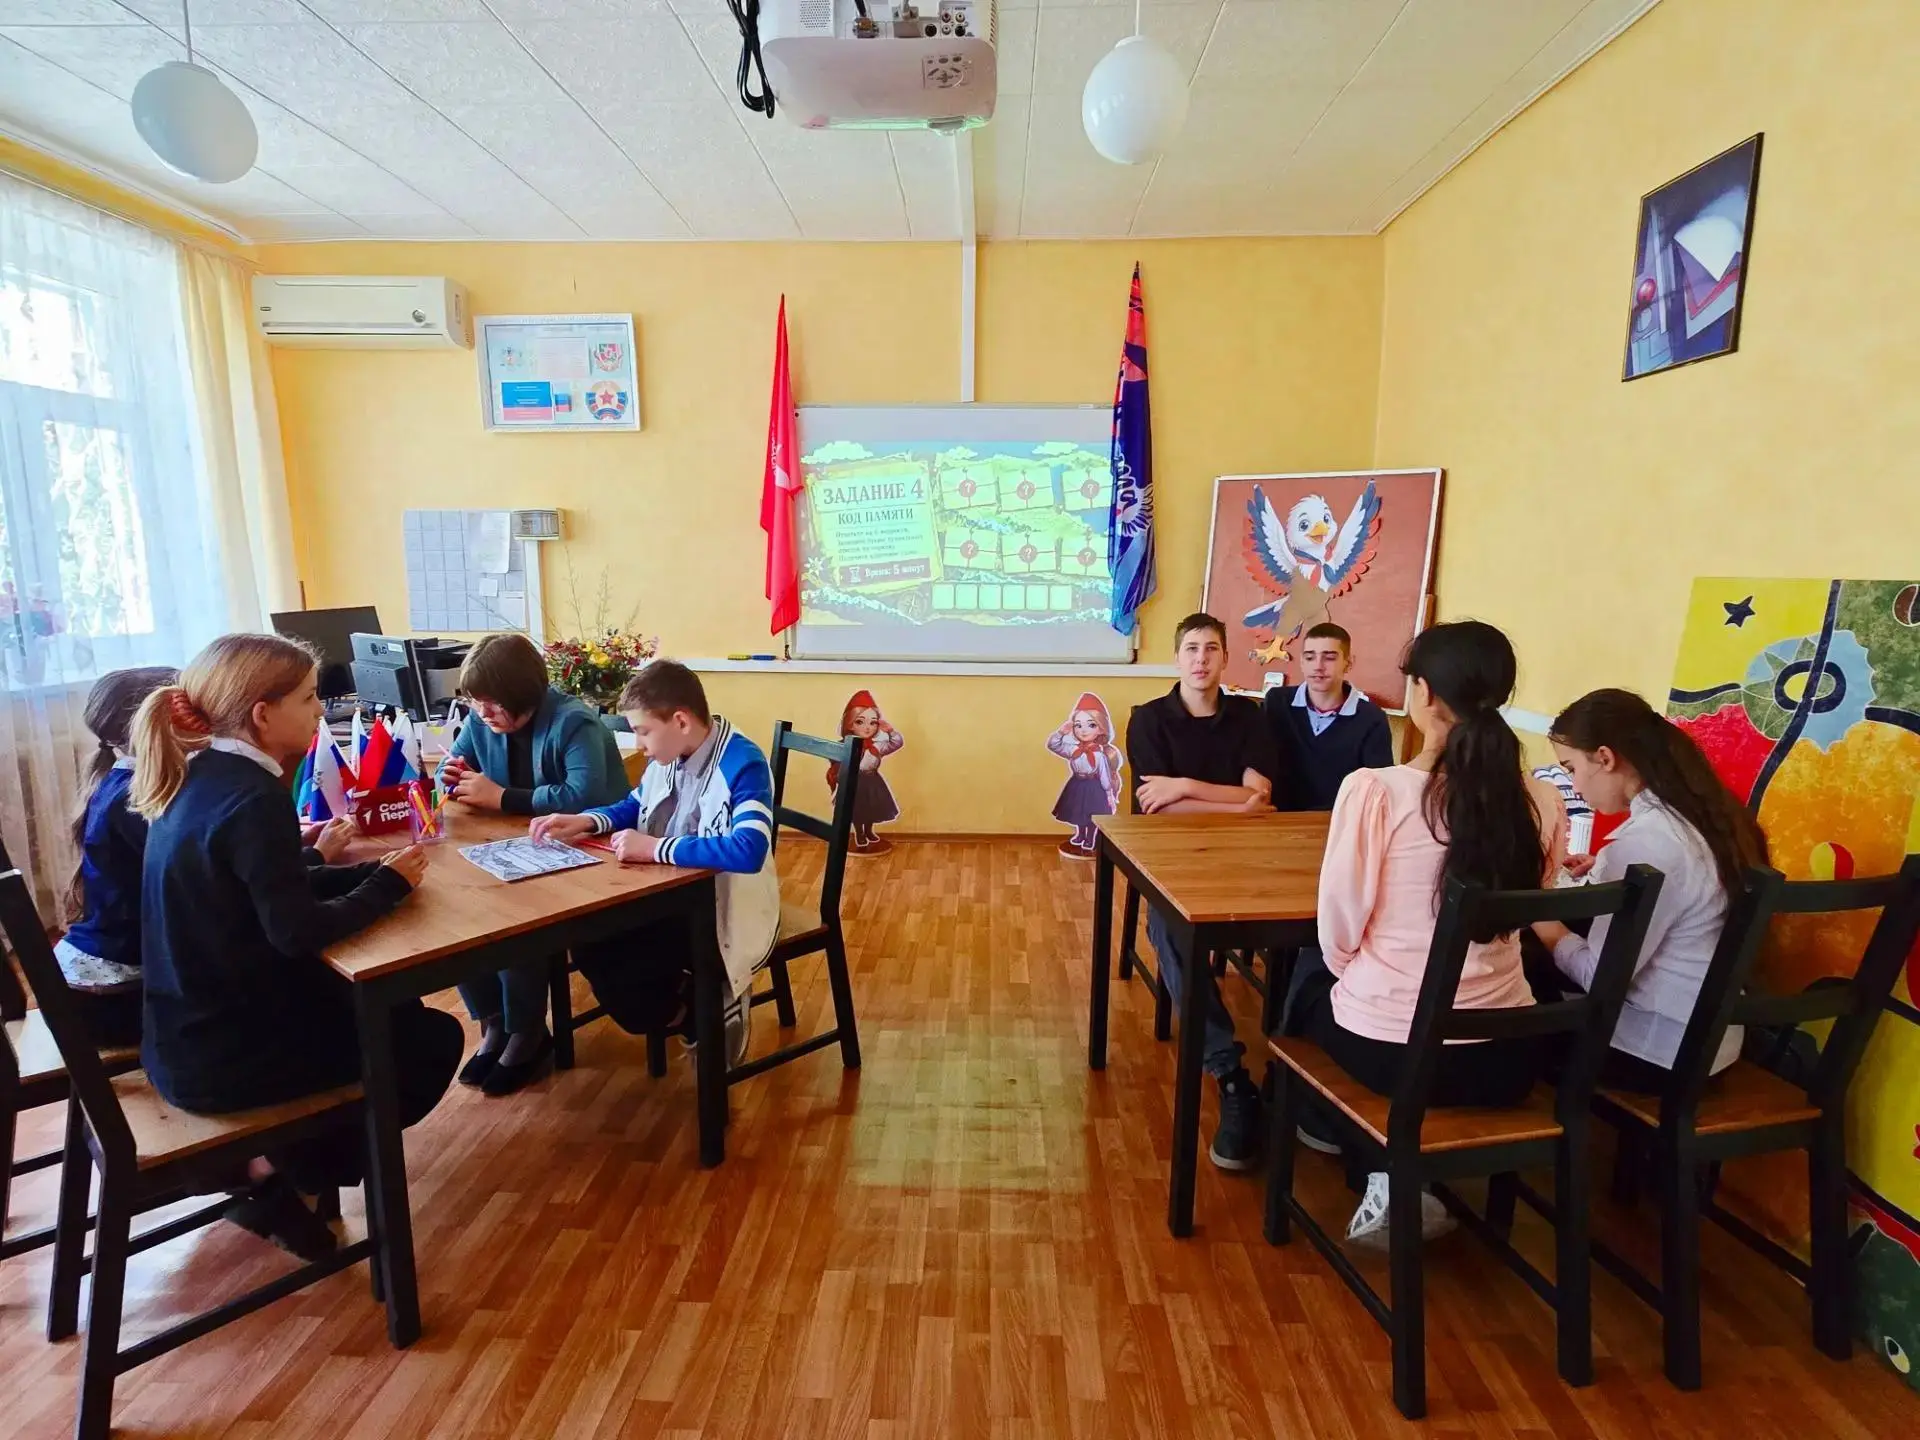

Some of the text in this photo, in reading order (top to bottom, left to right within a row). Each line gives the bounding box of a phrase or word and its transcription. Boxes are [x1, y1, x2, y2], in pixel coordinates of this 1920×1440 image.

[823, 478, 924, 505] ЗАДАНИЕ 4
[838, 508, 914, 525] КОД ПАМЯТИ
[893, 564, 900, 575] 5
